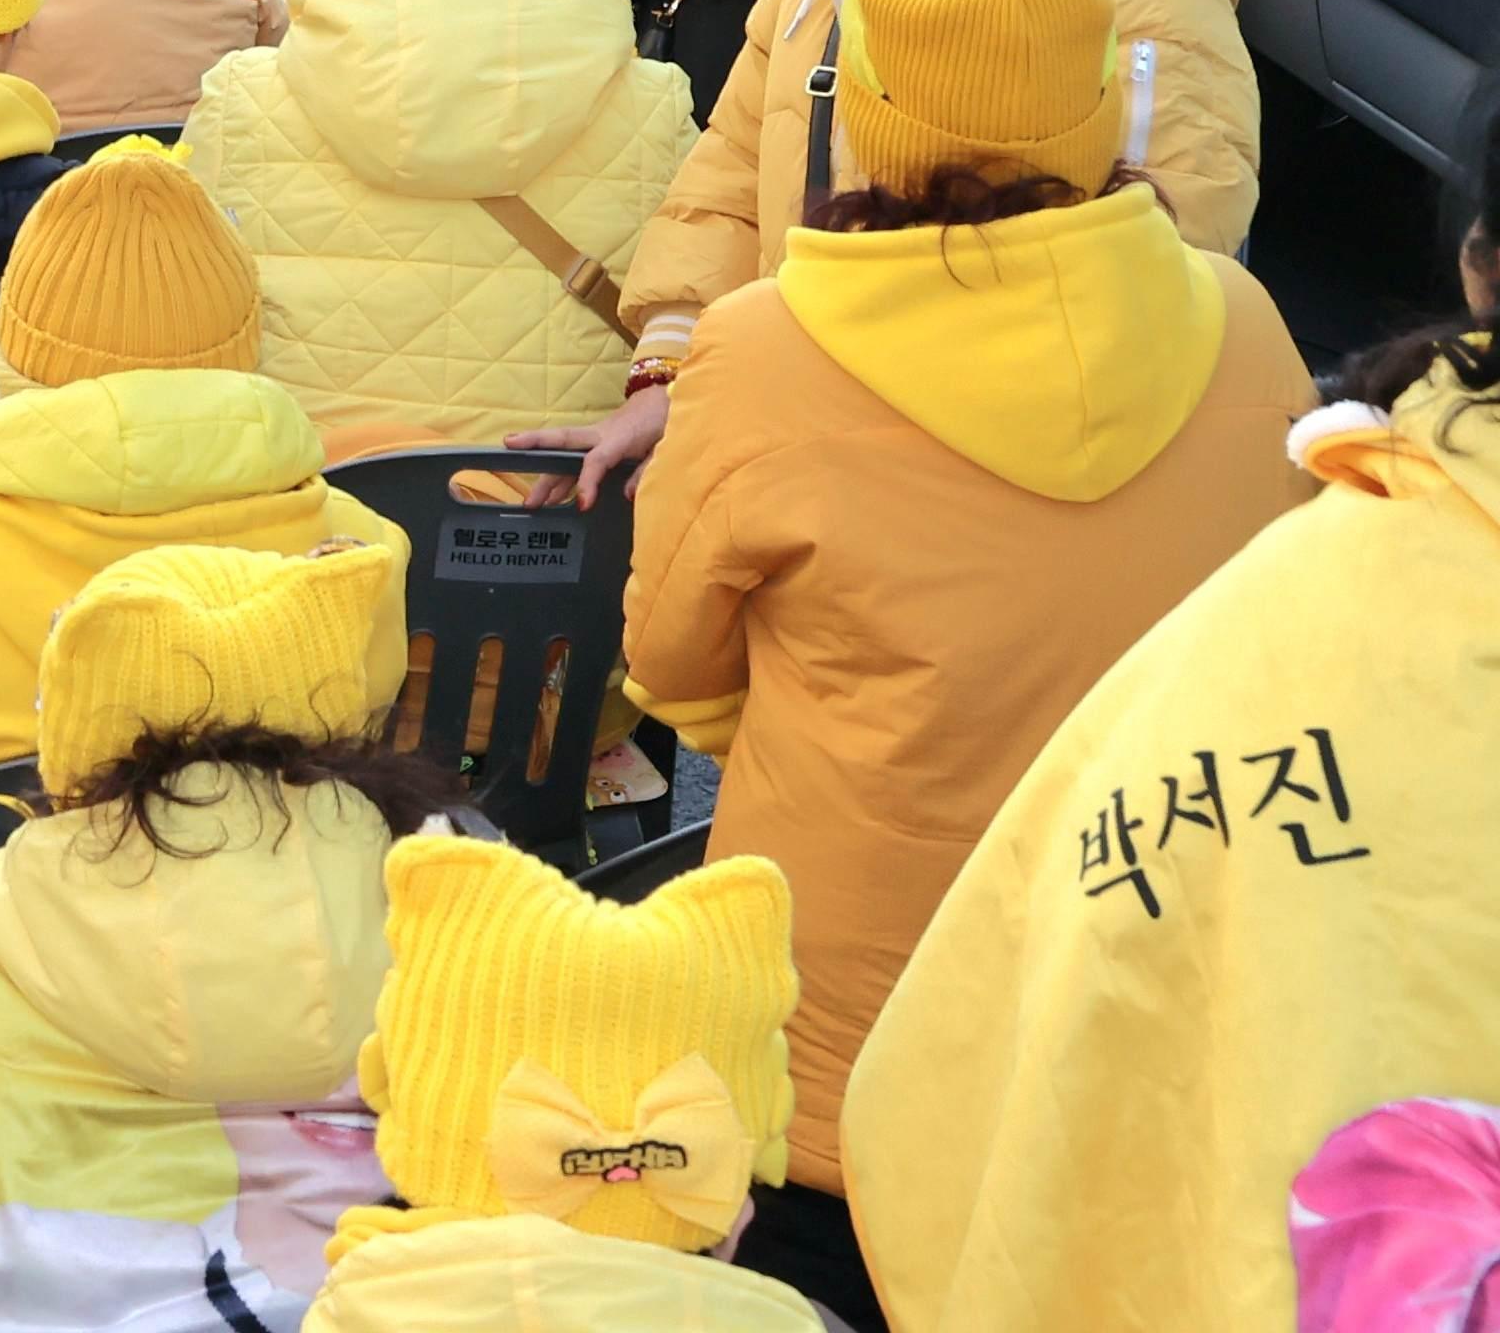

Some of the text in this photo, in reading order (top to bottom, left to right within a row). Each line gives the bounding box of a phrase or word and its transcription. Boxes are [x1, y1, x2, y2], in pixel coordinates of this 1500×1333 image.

[453, 528, 573, 549] 헬로우 렌탈
[451, 552, 568, 566] HELLO RENTAL
[1080, 728, 1371, 920] 박서진
